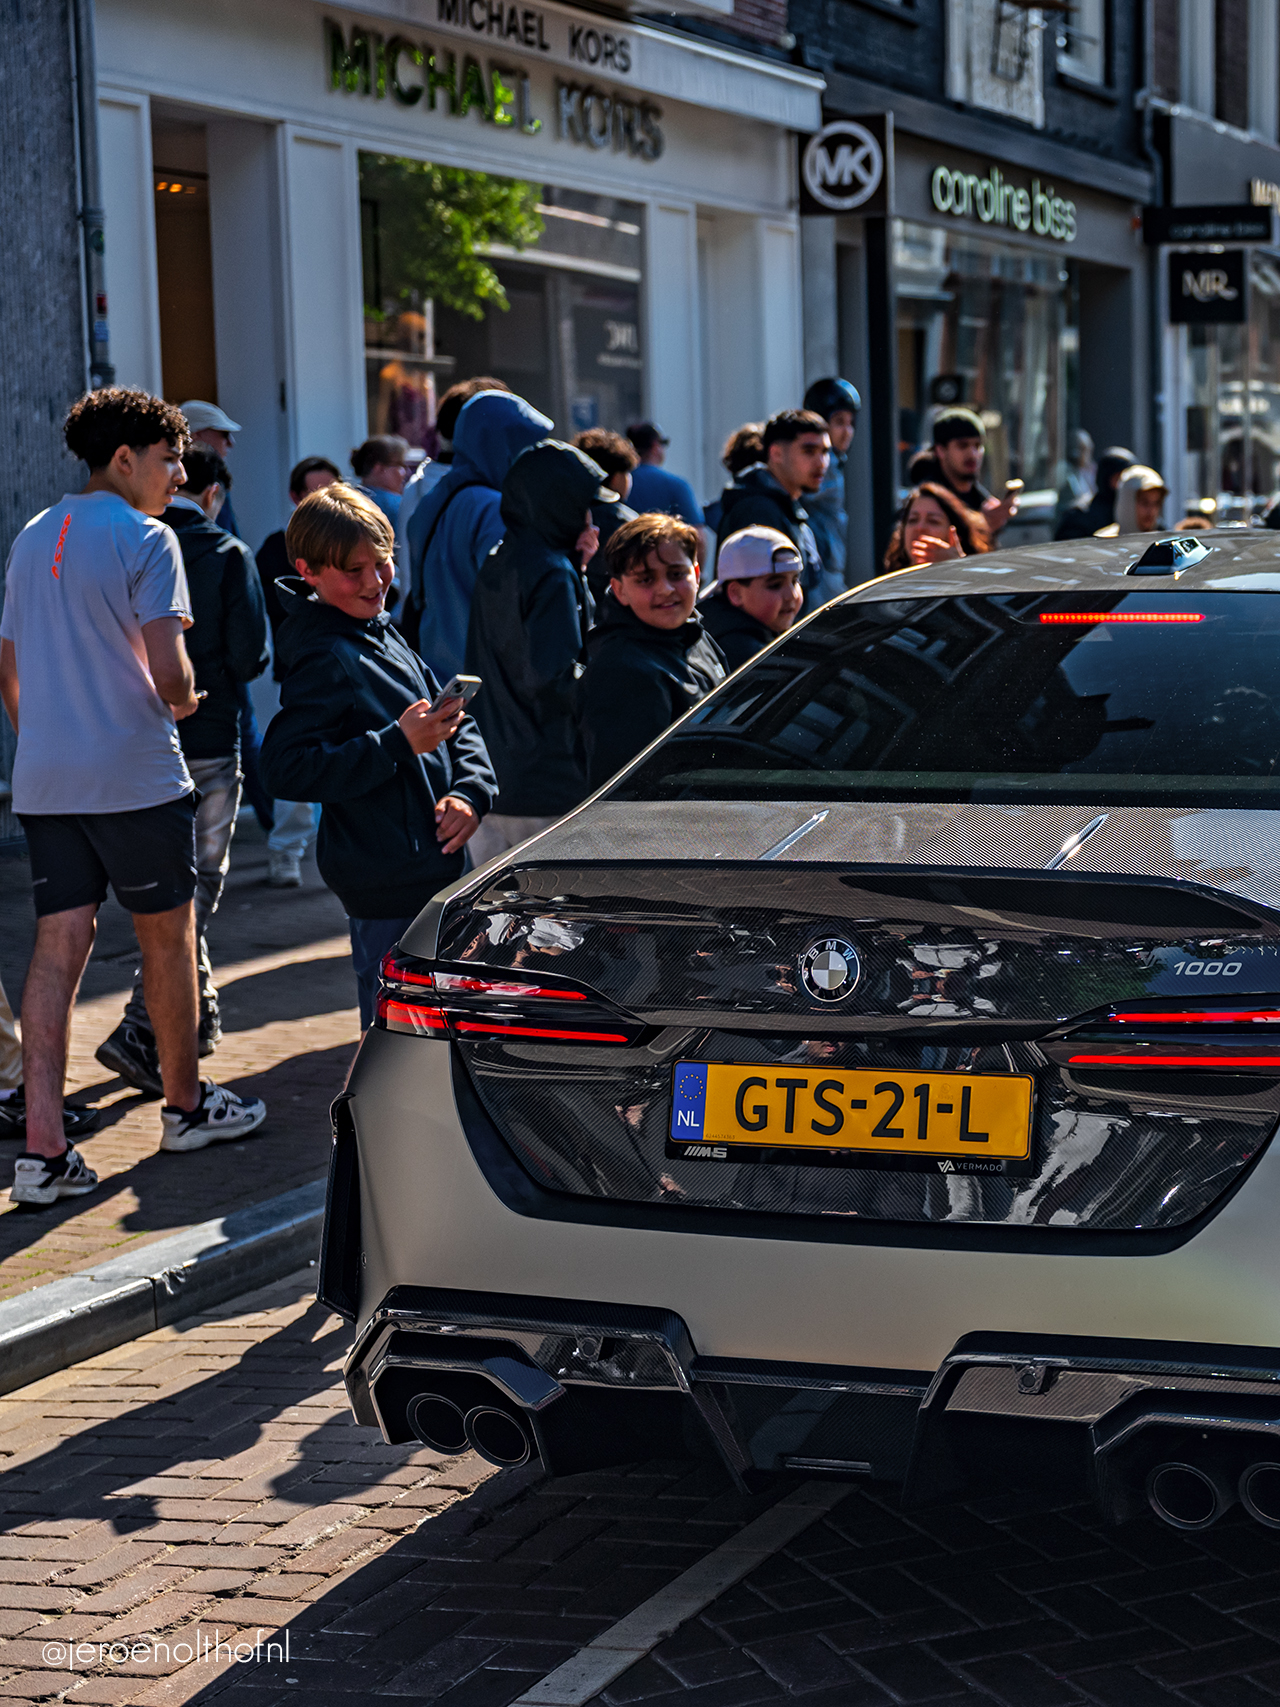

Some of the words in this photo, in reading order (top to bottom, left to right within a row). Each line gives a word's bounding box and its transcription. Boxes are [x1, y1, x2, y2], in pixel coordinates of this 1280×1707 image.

[437, 0, 550, 51] MICHAEL
[568, 22, 632, 73] KORS
[325, 16, 543, 136] MICHAEL
[556, 77, 666, 162] KORS
[815, 144, 874, 187] MK
[931, 164, 1031, 232] caroline
[1031, 177, 1078, 242] biss
[808, 940, 855, 961] BMW
[1173, 961, 1243, 976] 1000
[676, 1109, 701, 1128] NL
[734, 1076, 990, 1143] GTS-21-L
[956, 1162, 1004, 1173] VERMADO
